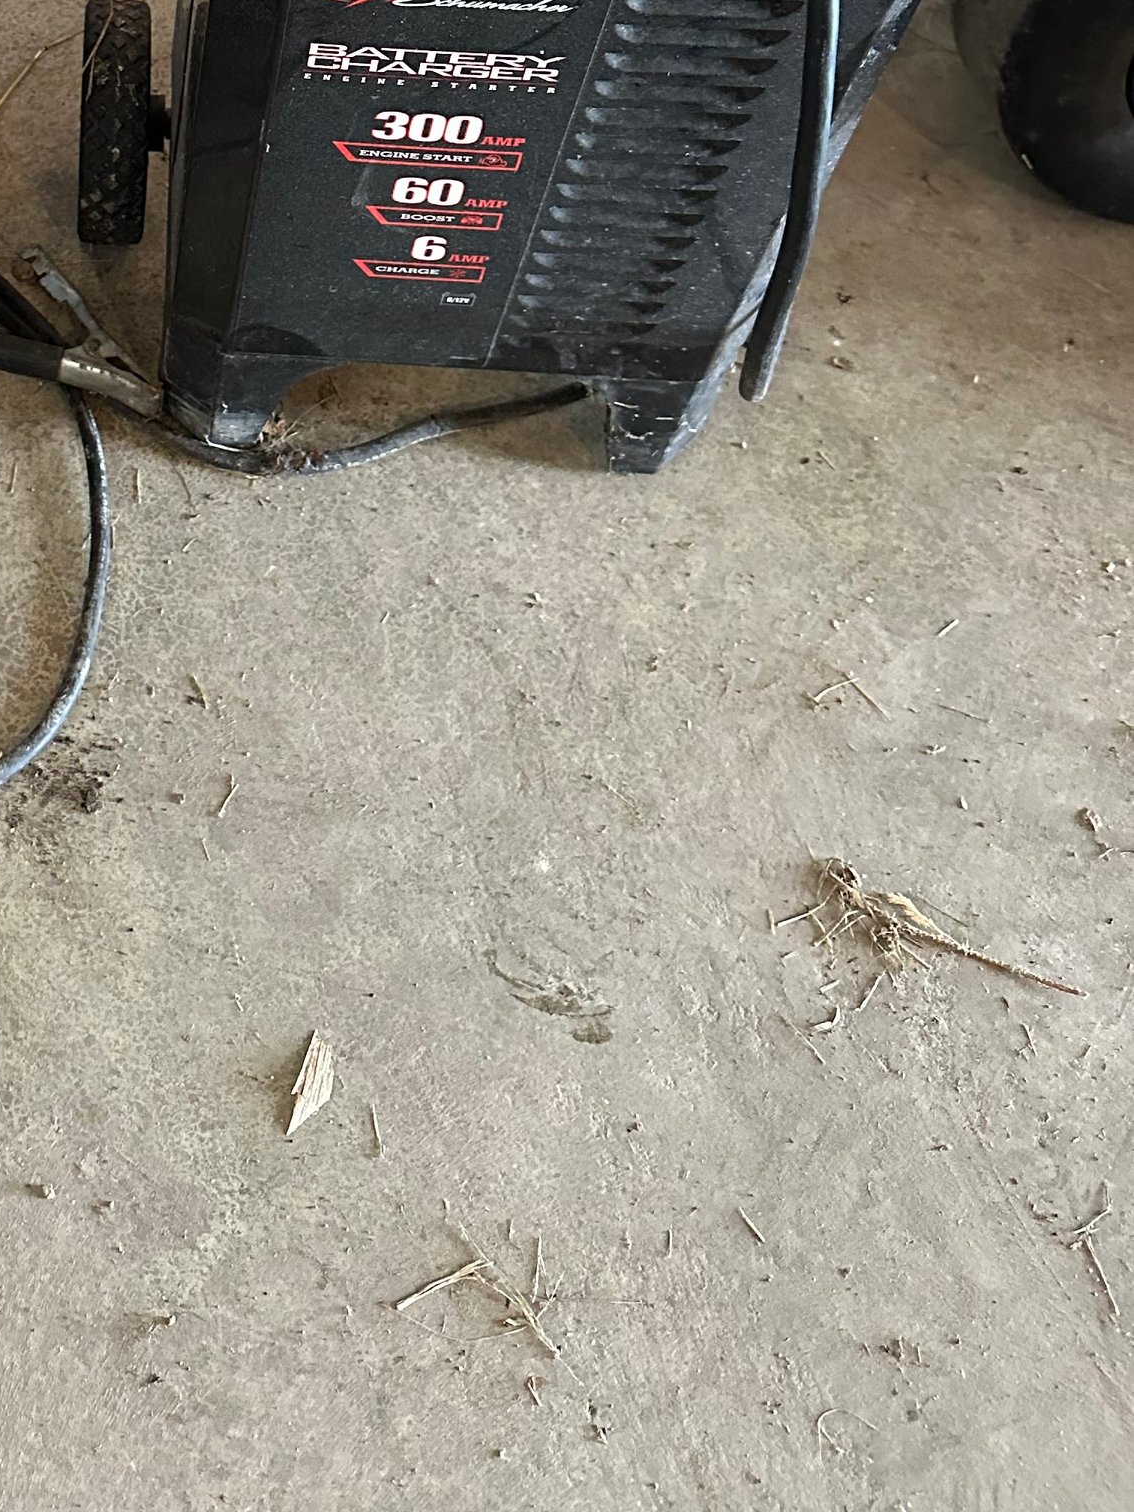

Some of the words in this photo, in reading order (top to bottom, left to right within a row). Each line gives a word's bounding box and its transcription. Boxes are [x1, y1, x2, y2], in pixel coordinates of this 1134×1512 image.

[308, 42, 566, 68] BATTERY
[307, 55, 560, 83] CHARGER
[304, 72, 405, 86] ENGINE
[431, 80, 556, 94] STARTER
[371, 111, 484, 145] 300
[481, 136, 527, 148] AMP
[359, 149, 421, 161] ENGINE
[422, 153, 474, 163] START
[392, 176, 466, 206] 60
[465, 198, 508, 209] AMP
[400, 213, 456, 223] BOOST
[410, 235, 448, 262] 6
[448, 254, 490, 264] AMP
[375, 265, 441, 276] CHARGE
